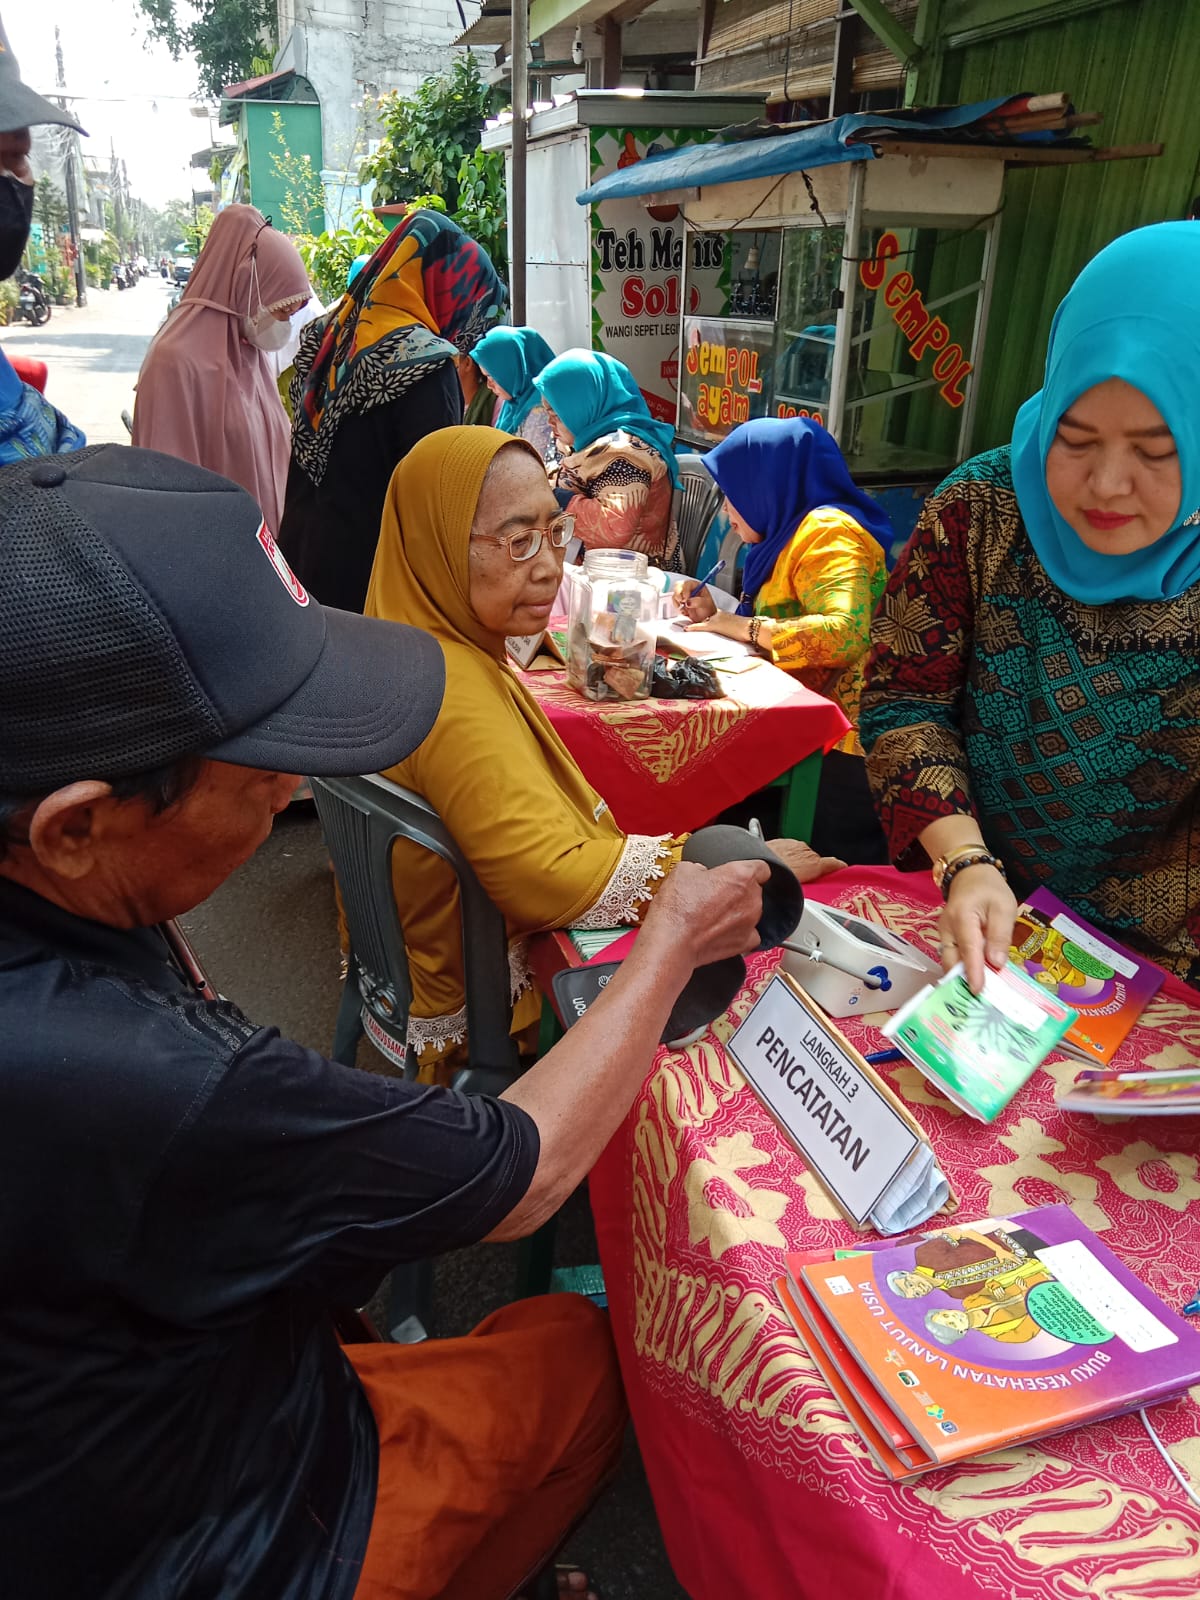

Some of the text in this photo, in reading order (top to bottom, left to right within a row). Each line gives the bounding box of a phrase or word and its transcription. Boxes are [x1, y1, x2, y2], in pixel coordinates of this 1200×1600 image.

[597, 229, 645, 271] Teh
[606, 325, 633, 338] WANGI
[634, 324, 659, 336] SEPET
[697, 383, 749, 425] ayam
[802, 1029, 859, 1099] LANGKAH 3
[756, 1026, 870, 1173] PENCATATAN
[858, 1280, 886, 1317] USIA
[880, 1319, 949, 1371] LANJUT
[953, 1364, 1071, 1391] KESEHATAN
[1070, 1350, 1111, 1383] BUKU
